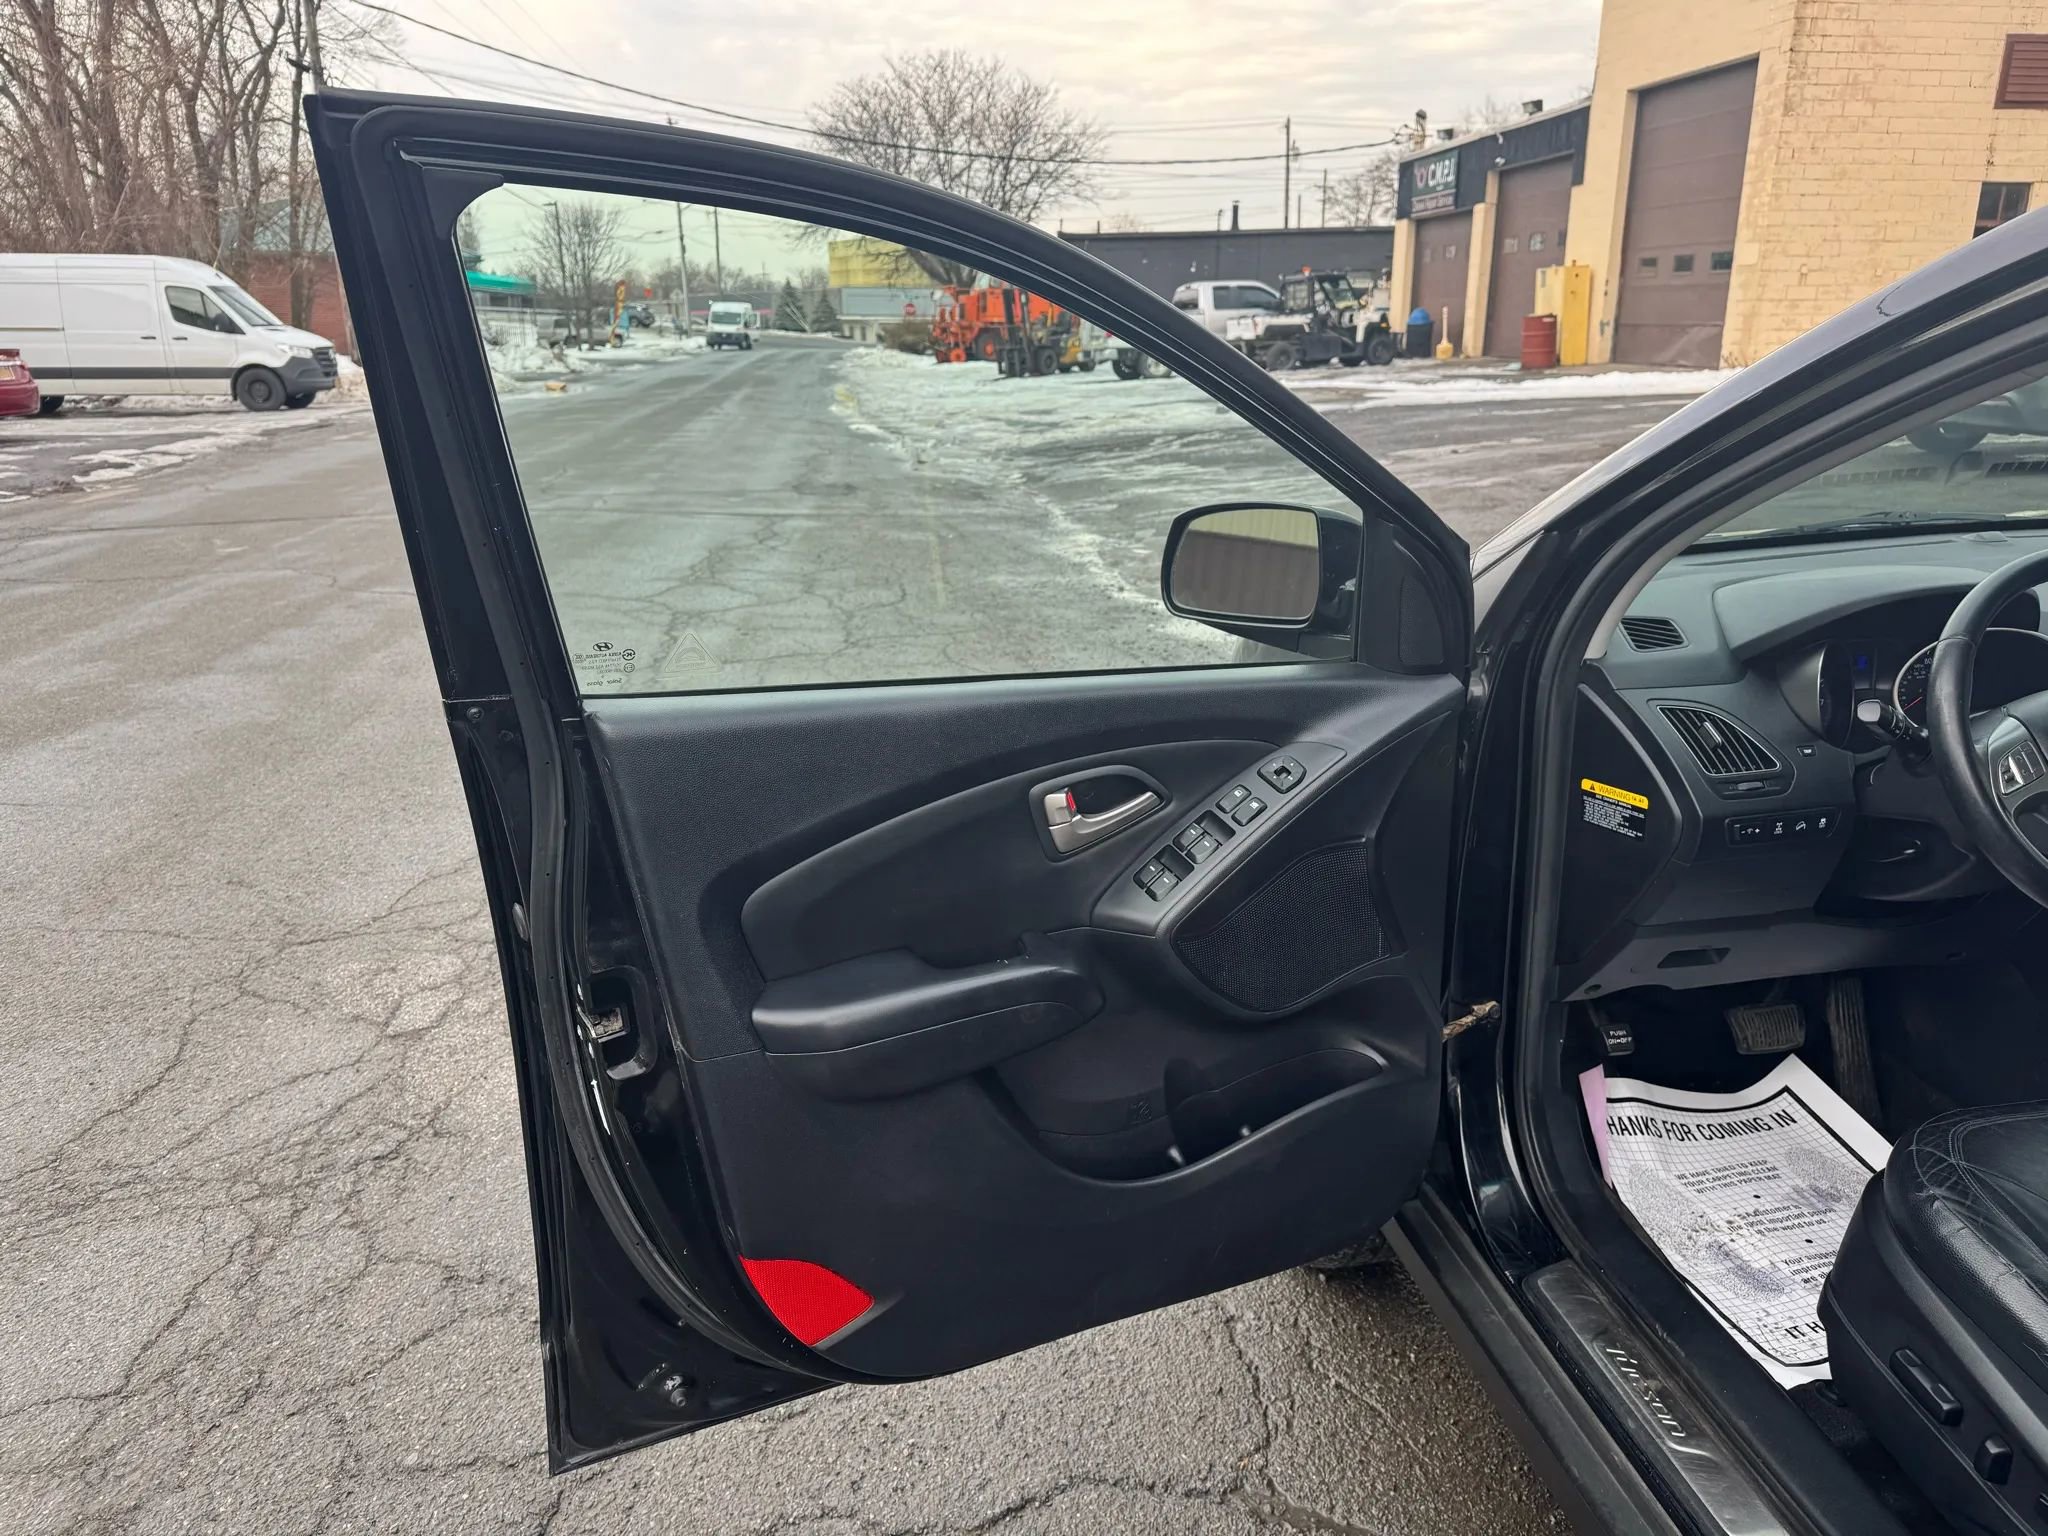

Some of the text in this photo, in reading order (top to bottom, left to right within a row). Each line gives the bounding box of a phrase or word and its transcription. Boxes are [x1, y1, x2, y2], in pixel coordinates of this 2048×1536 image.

[1598, 784, 1631, 801] WARNING
[1606, 1109, 1798, 1142] HANKS FOR COMING IN
[1675, 1159, 1769, 1180] WE HAVE TRIED TO KEEP
[1681, 1165, 1779, 1189] YOUR CARPETING CLEAN
[1694, 1173, 1783, 1195] WITH THIS PAPER MAT
[1727, 1223, 1743, 1233] the
[1764, 1211, 1808, 1225] important
[1763, 1225, 1779, 1234] the
[1780, 1220, 1805, 1231] world
[1803, 1220, 1815, 1228] to
[1782, 1256, 1805, 1267] Your
[1801, 1275, 1817, 1284] are
[1784, 1321, 1826, 1339] IT H
